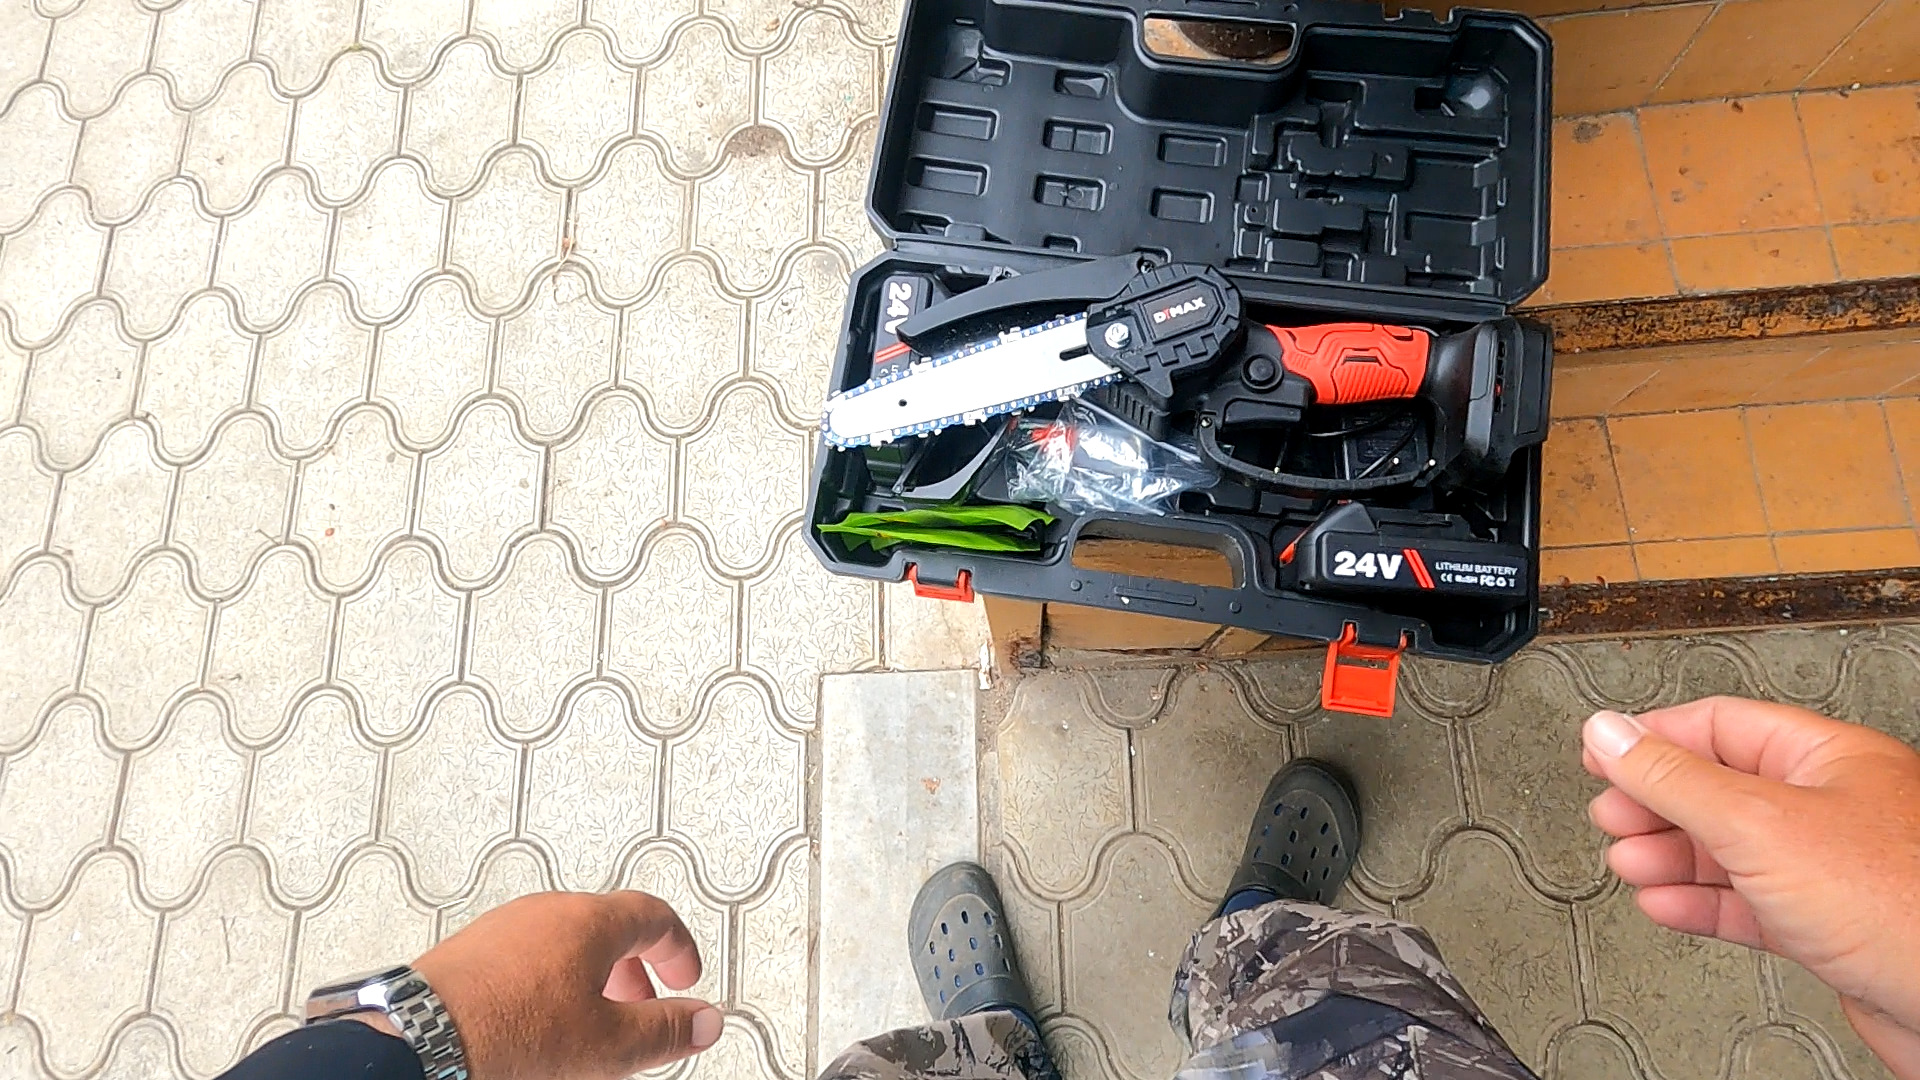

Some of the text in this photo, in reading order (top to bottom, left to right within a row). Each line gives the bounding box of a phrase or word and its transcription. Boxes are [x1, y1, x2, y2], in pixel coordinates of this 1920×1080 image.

[1333, 551, 1403, 580] 24V
[1435, 561, 1518, 576] LITHIUM BATTERY
